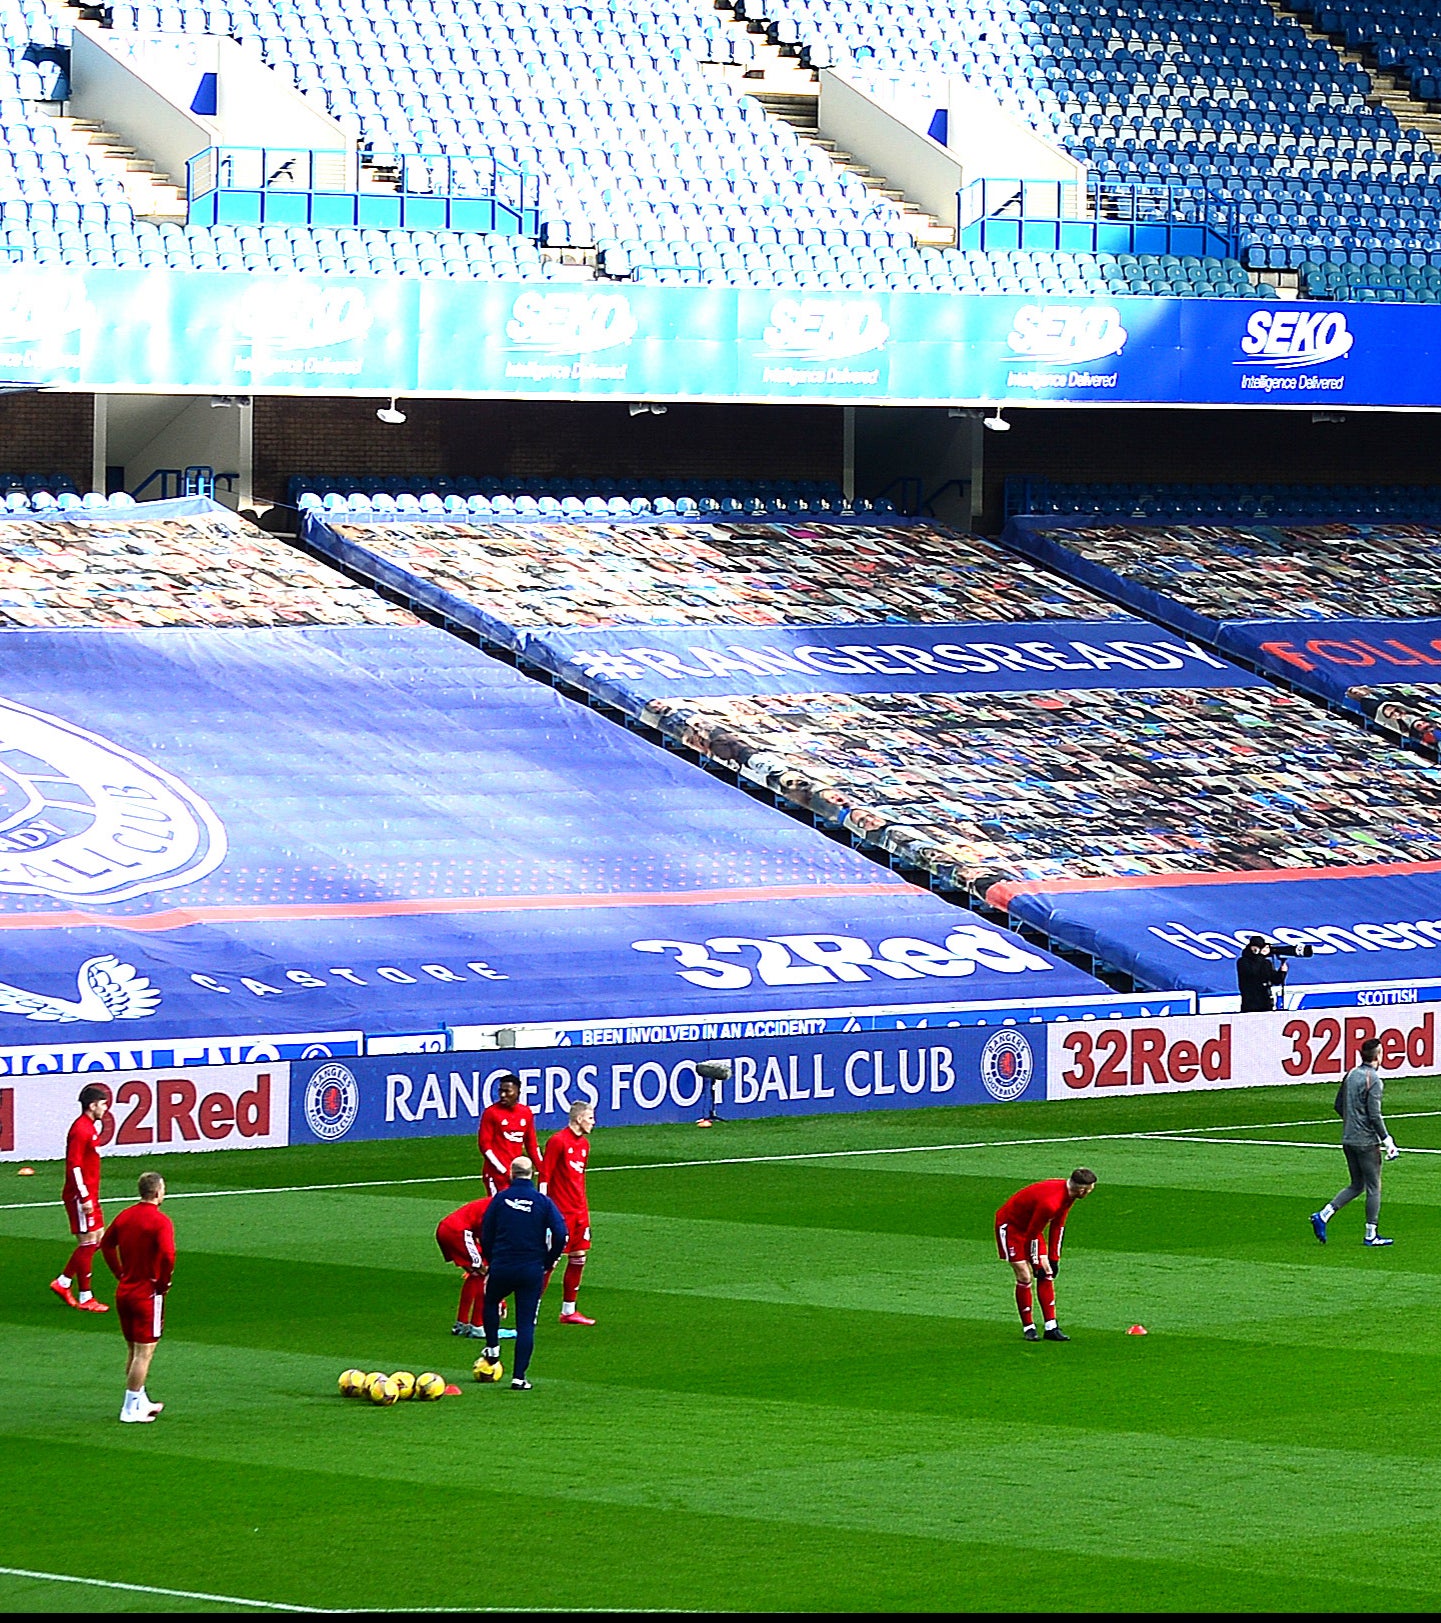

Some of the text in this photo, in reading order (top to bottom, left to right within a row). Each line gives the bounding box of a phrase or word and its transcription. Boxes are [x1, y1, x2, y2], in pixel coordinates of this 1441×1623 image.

[506, 291, 637, 341] SEKO
[763, 299, 889, 348] SEKO
[1007, 305, 1128, 354] SEKO
[1241, 310, 1353, 357] SEKO
[1068, 372, 1117, 389] Delivered
[1241, 374, 1344, 392] Intelligence Delivered
[570, 640, 1228, 680] #RANGERSREADY
[190, 961, 509, 997] CASTORE
[631, 923, 1054, 990] 32Red
[1357, 989, 1417, 1005] SCOTTISH
[582, 1019, 827, 1046] BEEN INVOLVED IN AN ACCIDENT?
[1062, 1023, 1232, 1090] 32Red
[1282, 1013, 1435, 1076] 32Red
[845, 1046, 957, 1096] CLUB
